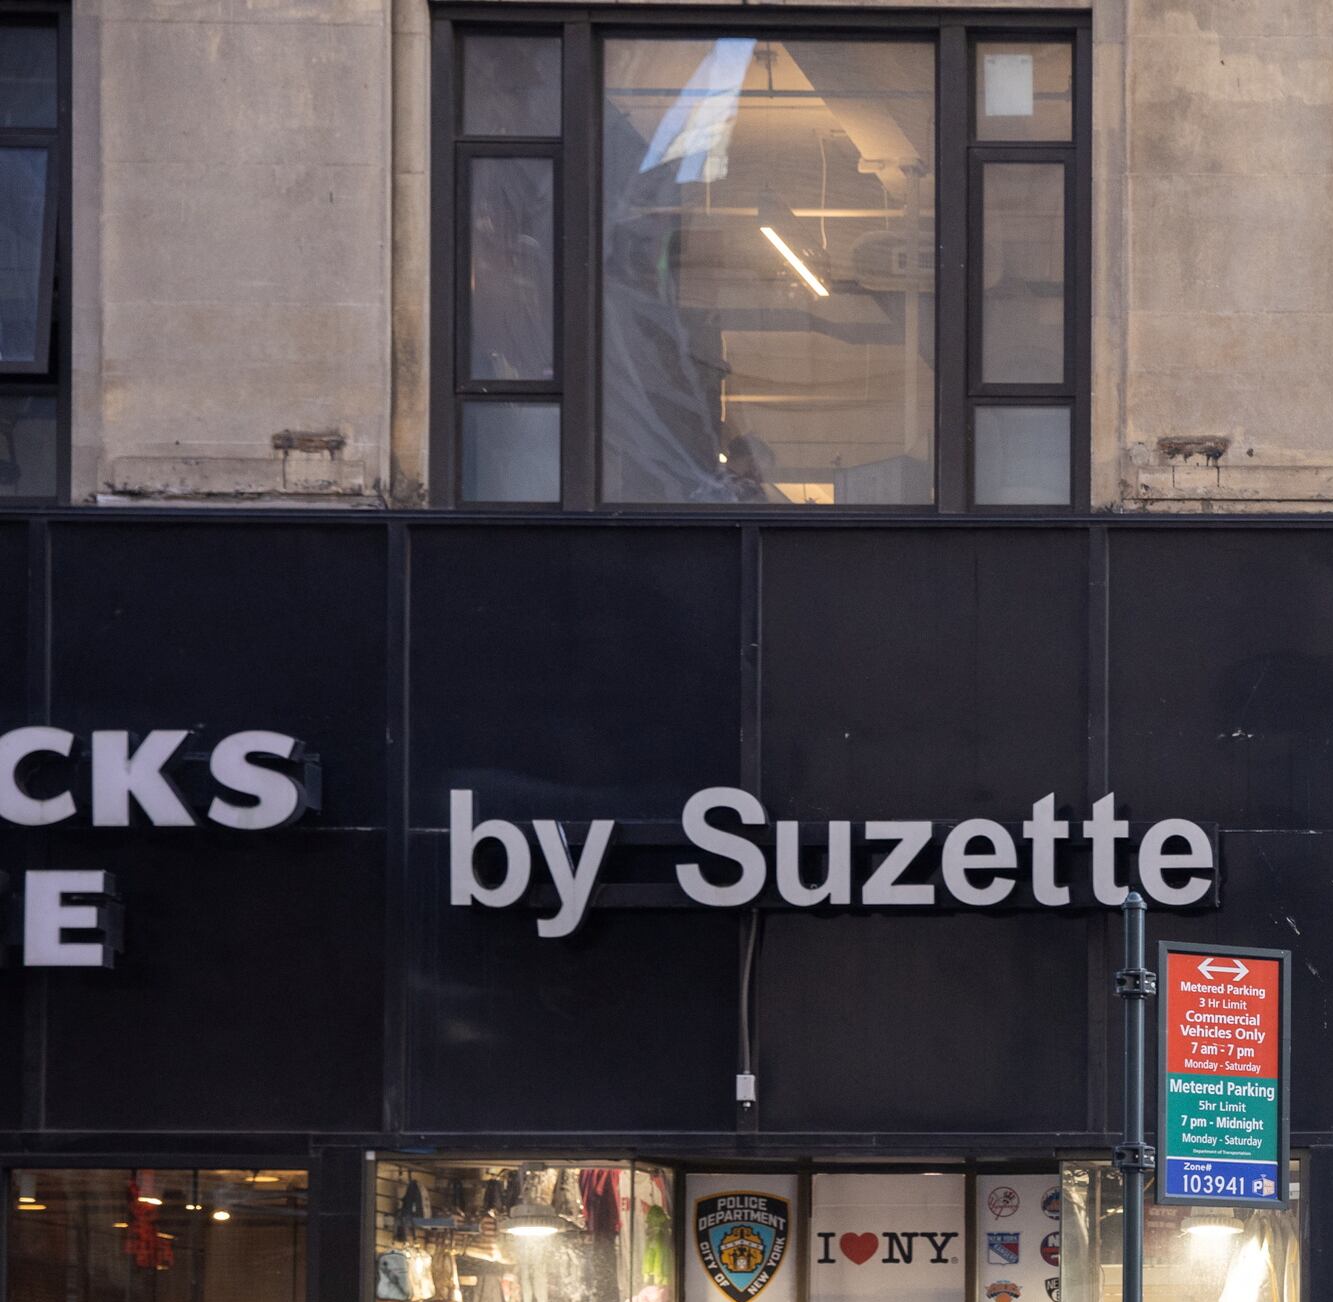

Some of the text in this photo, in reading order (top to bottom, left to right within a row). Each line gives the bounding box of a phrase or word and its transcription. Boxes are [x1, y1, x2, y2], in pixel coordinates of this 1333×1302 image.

[0, 726, 300, 830] CKS
[450, 786, 1213, 938] by Suzette
[24, 870, 104, 966] E
[1180, 981, 1266, 999] Metered Parking
[1199, 998, 1247, 1010] 3 Hr Limit
[1185, 1010, 1260, 1026] Commercial
[1180, 1024, 1266, 1043] Vehicles Only
[1191, 1042, 1254, 1059] 7 am 7 pm
[1184, 1059, 1261, 1074] Monday Saturday
[1170, 1078, 1275, 1101] Metered Parking
[1198, 1100, 1247, 1113] 5hr Limit
[1180, 1115, 1264, 1132] 7 pm Midnight
[1182, 1132, 1262, 1148] Monday Saturday
[1184, 1161, 1212, 1172] Zone#
[1182, 1173, 1246, 1195] 103941
[717, 1196, 768, 1210] POLICE
[699, 1209, 786, 1231] DEPARTMENT
[817, 1231, 836, 1264] I
[881, 1231, 959, 1264] NY
[700, 1241, 730, 1287] CITY OF
[747, 1237, 785, 1295] NEW YORK
